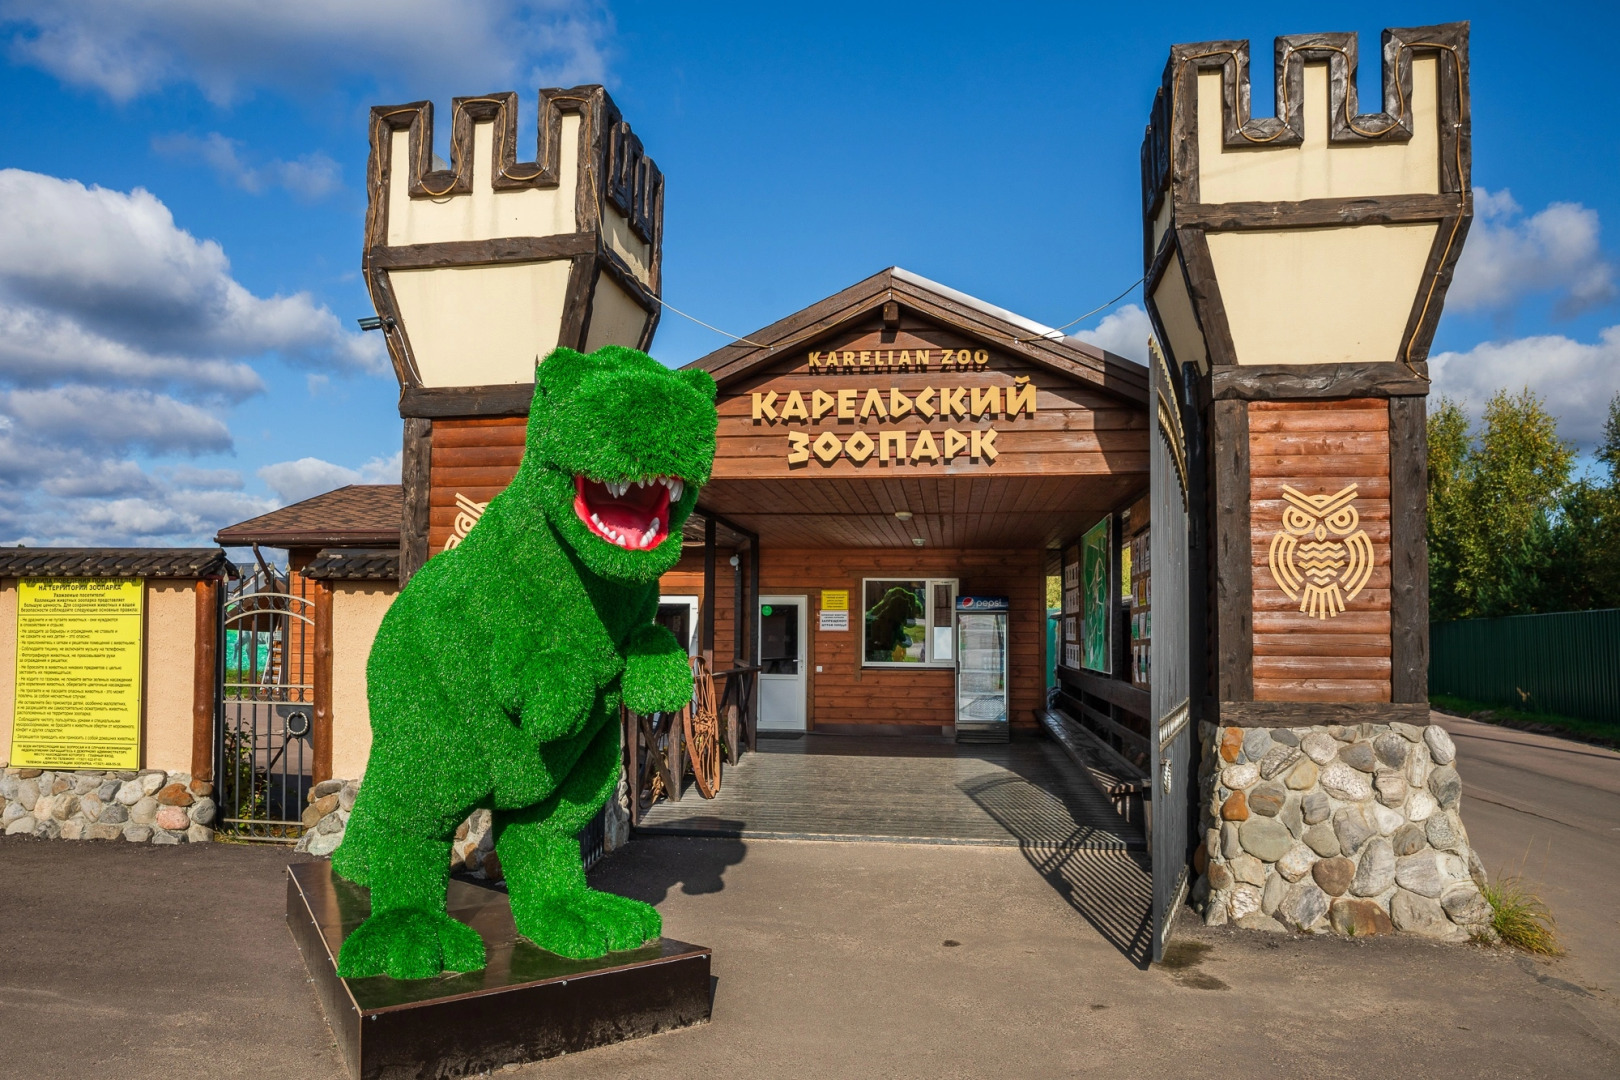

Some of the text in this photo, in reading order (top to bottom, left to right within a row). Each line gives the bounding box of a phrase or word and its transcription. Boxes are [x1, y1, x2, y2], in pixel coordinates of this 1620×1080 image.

[808, 349, 989, 367] KARELIAN ZOO
[751, 375, 1037, 421] КАРЕЛЬСКИЙ
[787, 428, 999, 464] ЗООПАРК
[976, 598, 1002, 608] pepsi
